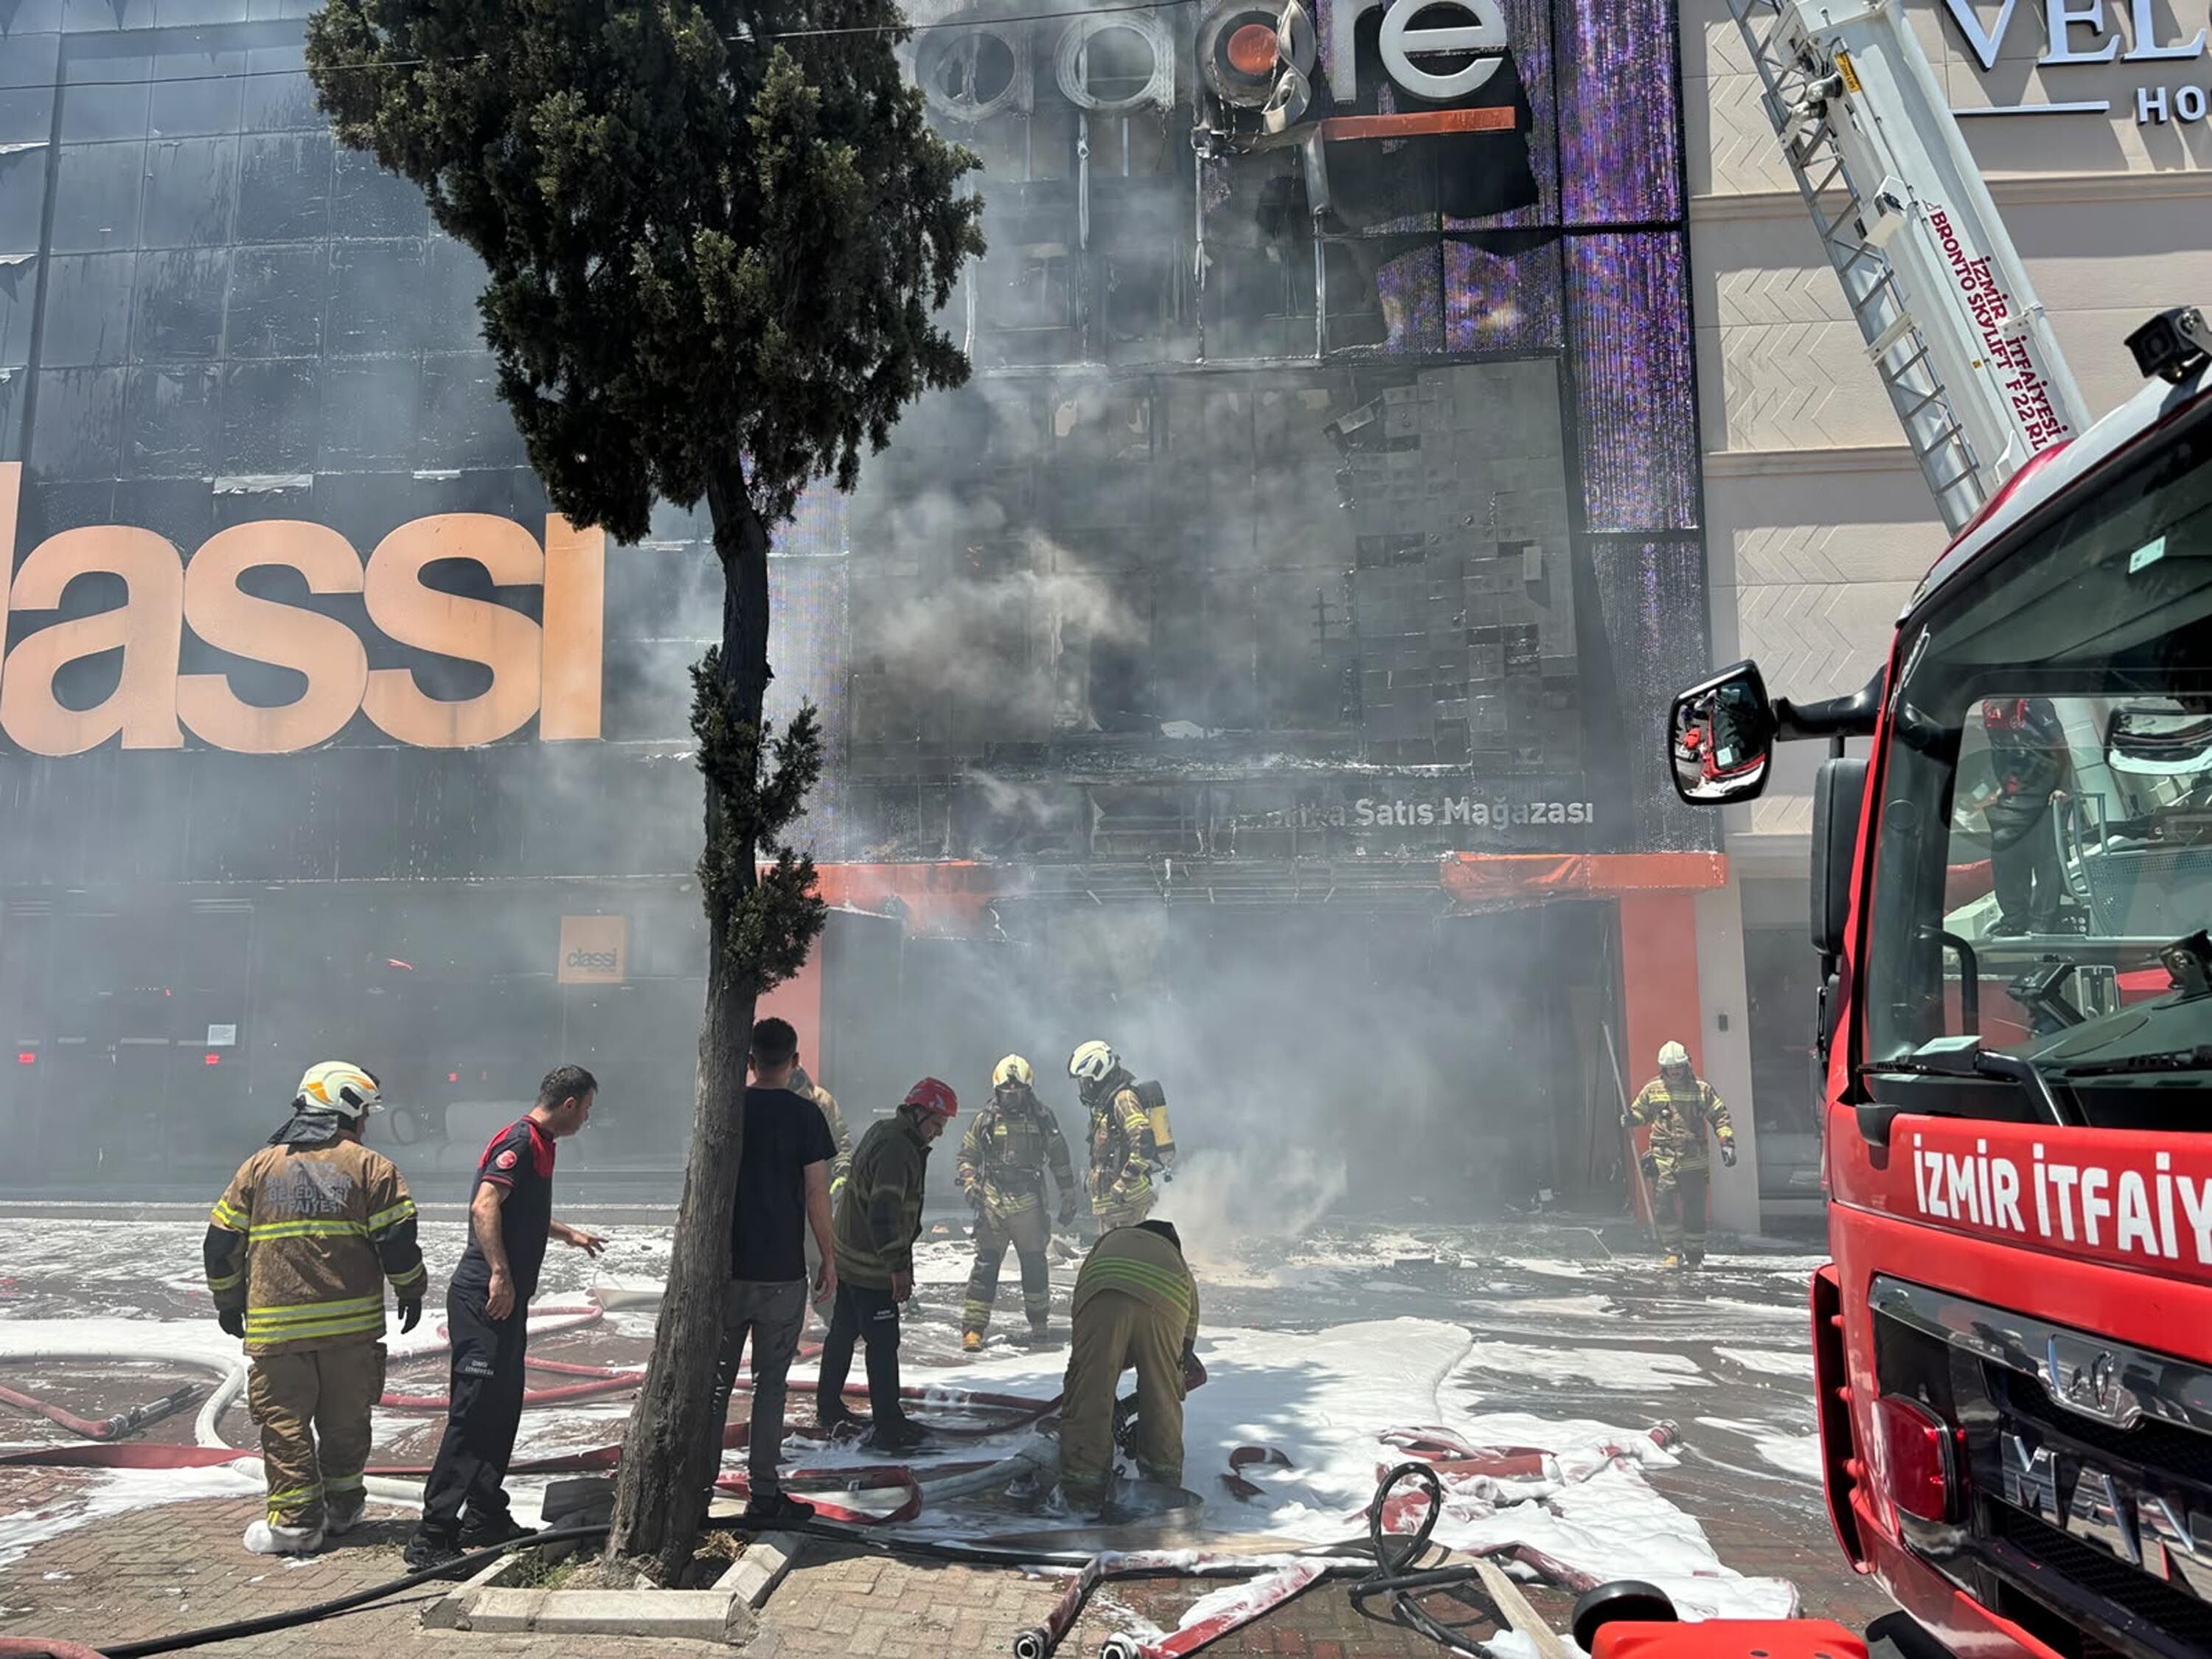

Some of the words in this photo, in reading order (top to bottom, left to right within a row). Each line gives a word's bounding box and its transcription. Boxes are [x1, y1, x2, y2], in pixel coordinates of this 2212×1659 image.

[1930, 210, 1977, 291] BRONTO
[1966, 293, 2014, 369] SKYLIFT
[1969, 255, 2008, 319] İZMİR
[2006, 335, 2068, 437] İTFAİYESİ
[2006, 378, 2024, 392] F
[2011, 392, 2038, 422] 22
[2025, 425, 2048, 451] RL
[566, 946, 617, 969] classi
[1913, 1133, 2026, 1233] İZMİR
[2000, 1430, 2212, 1607] MAN
